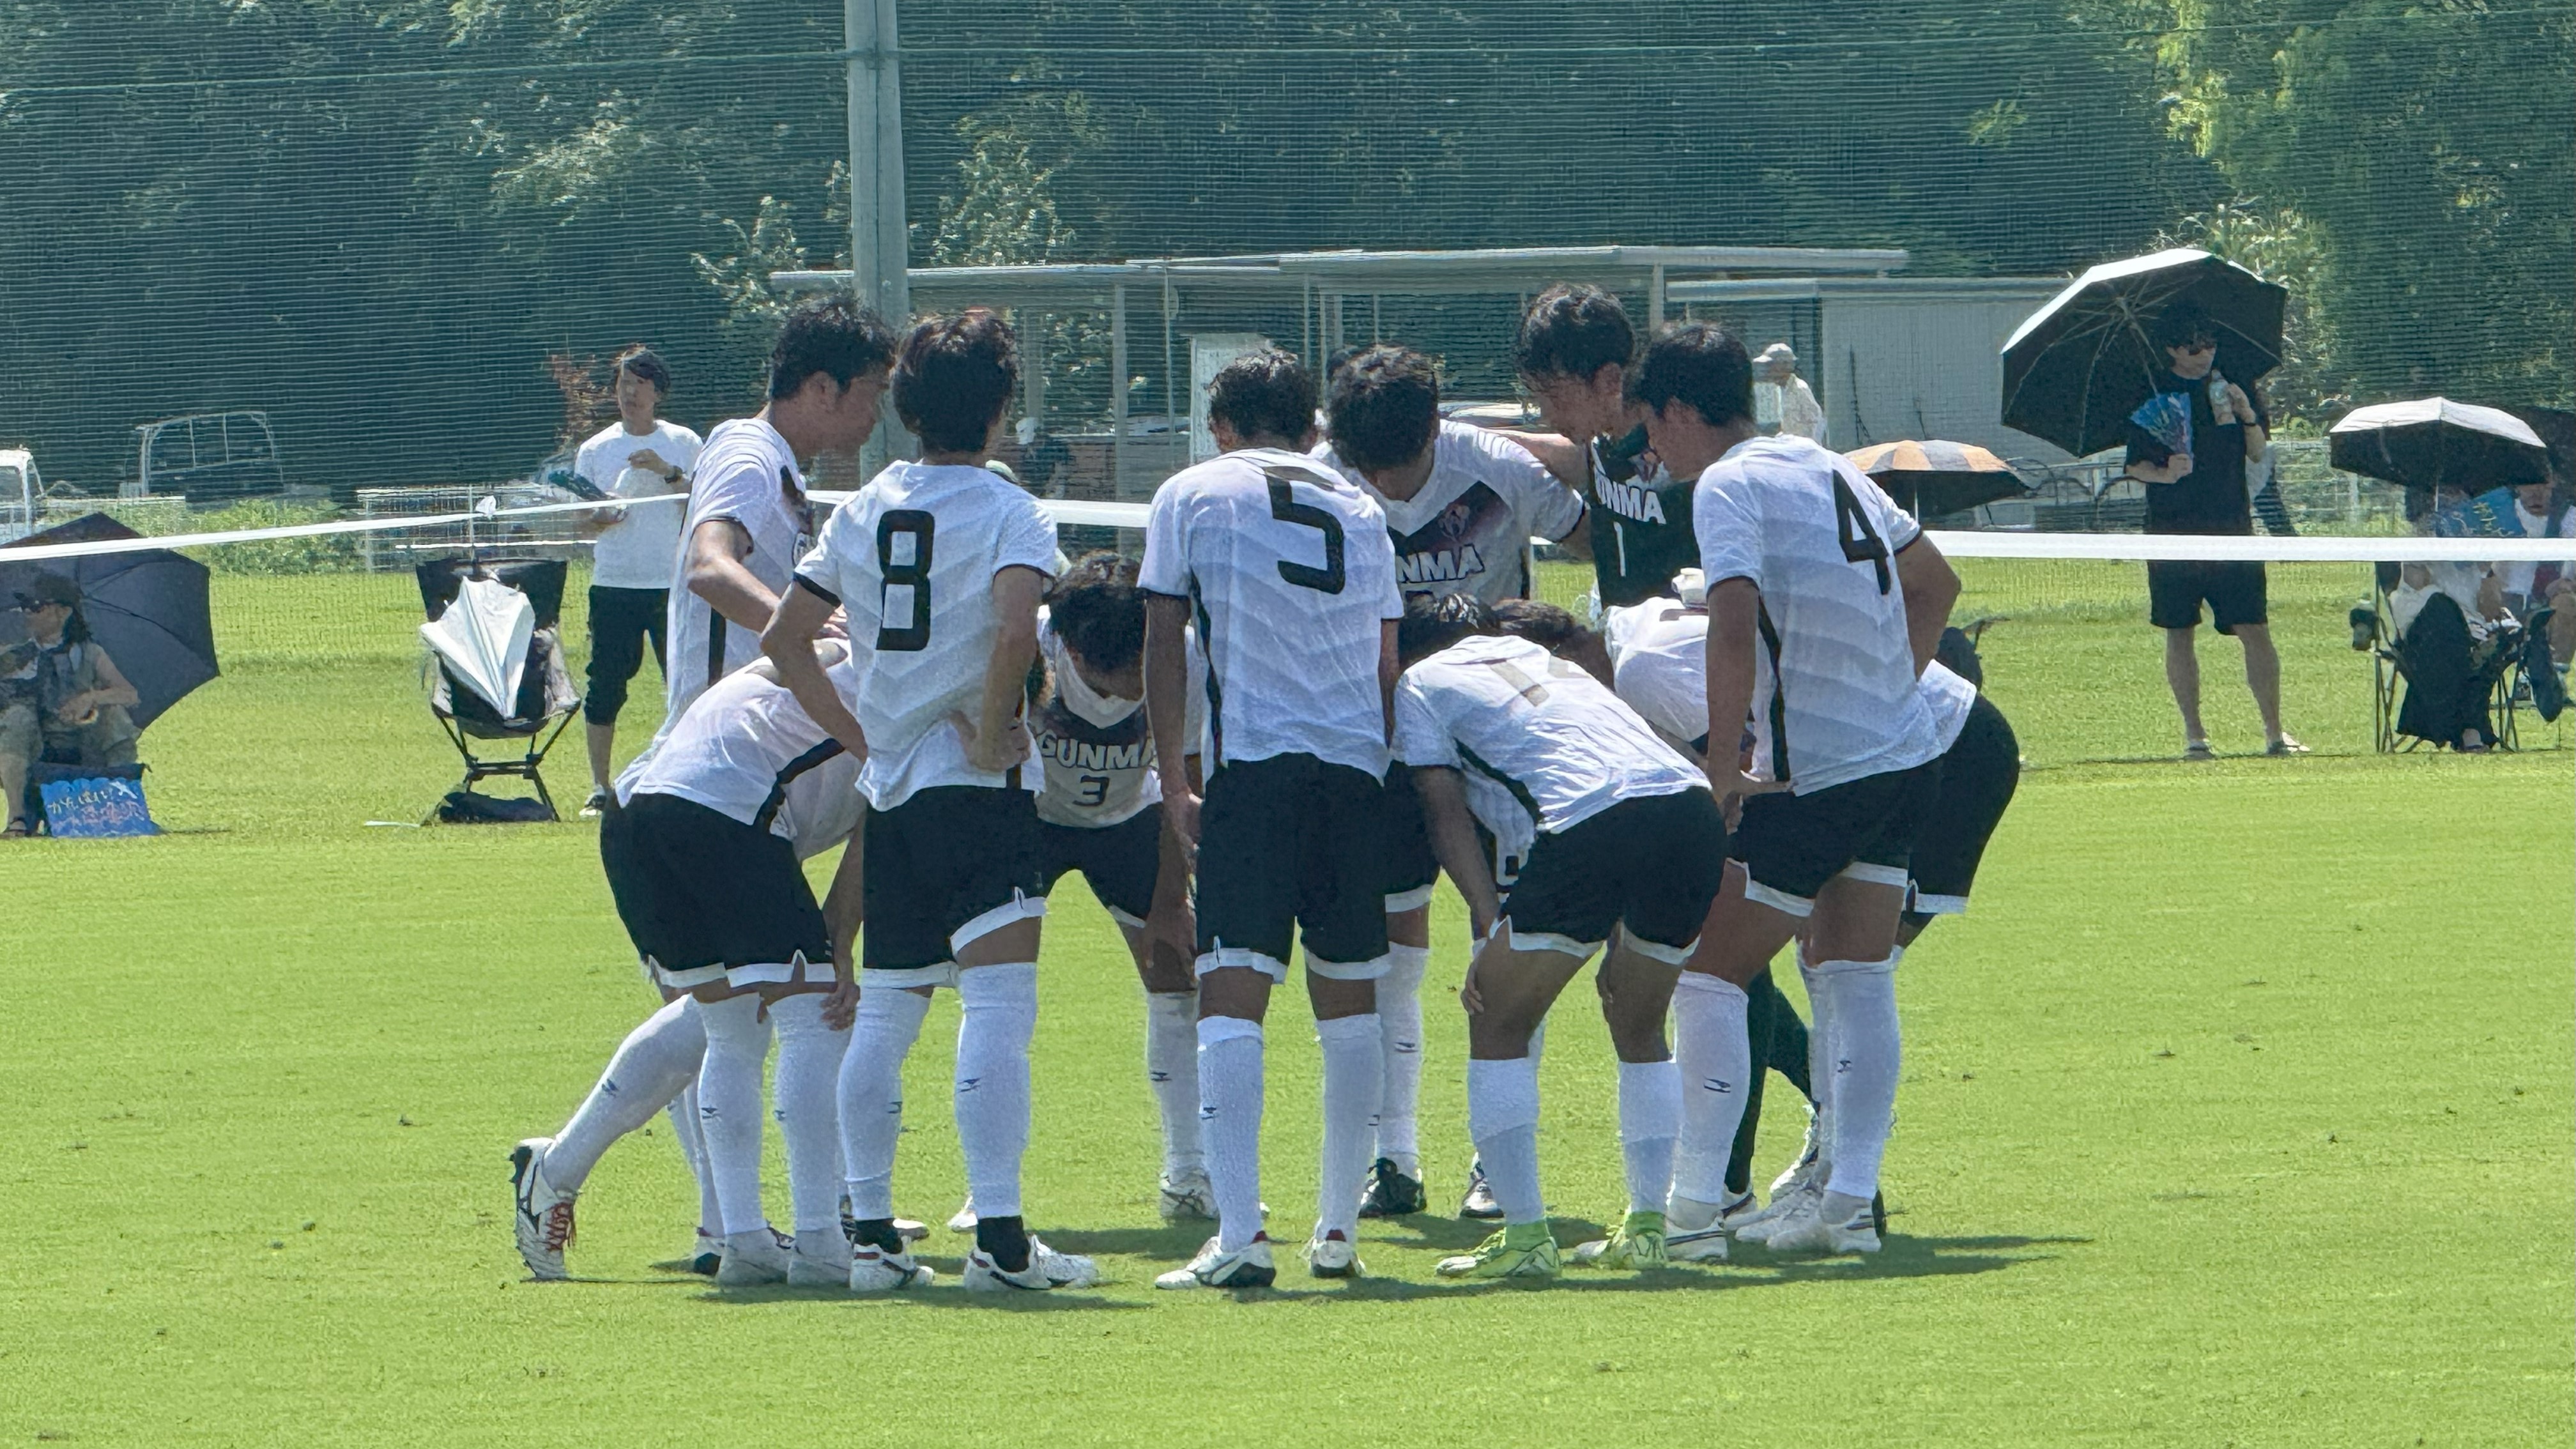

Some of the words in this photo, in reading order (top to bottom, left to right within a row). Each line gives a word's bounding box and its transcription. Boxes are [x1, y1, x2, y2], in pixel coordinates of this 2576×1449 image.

[1594, 464, 1666, 525] UNMA
[1264, 465, 1346, 594] 5
[1613, 521, 1626, 576] 1
[1832, 470, 1891, 595] 4
[875, 509, 935, 651] 8
[1395, 543, 1485, 583] NMA
[1073, 775, 1109, 806] 3
